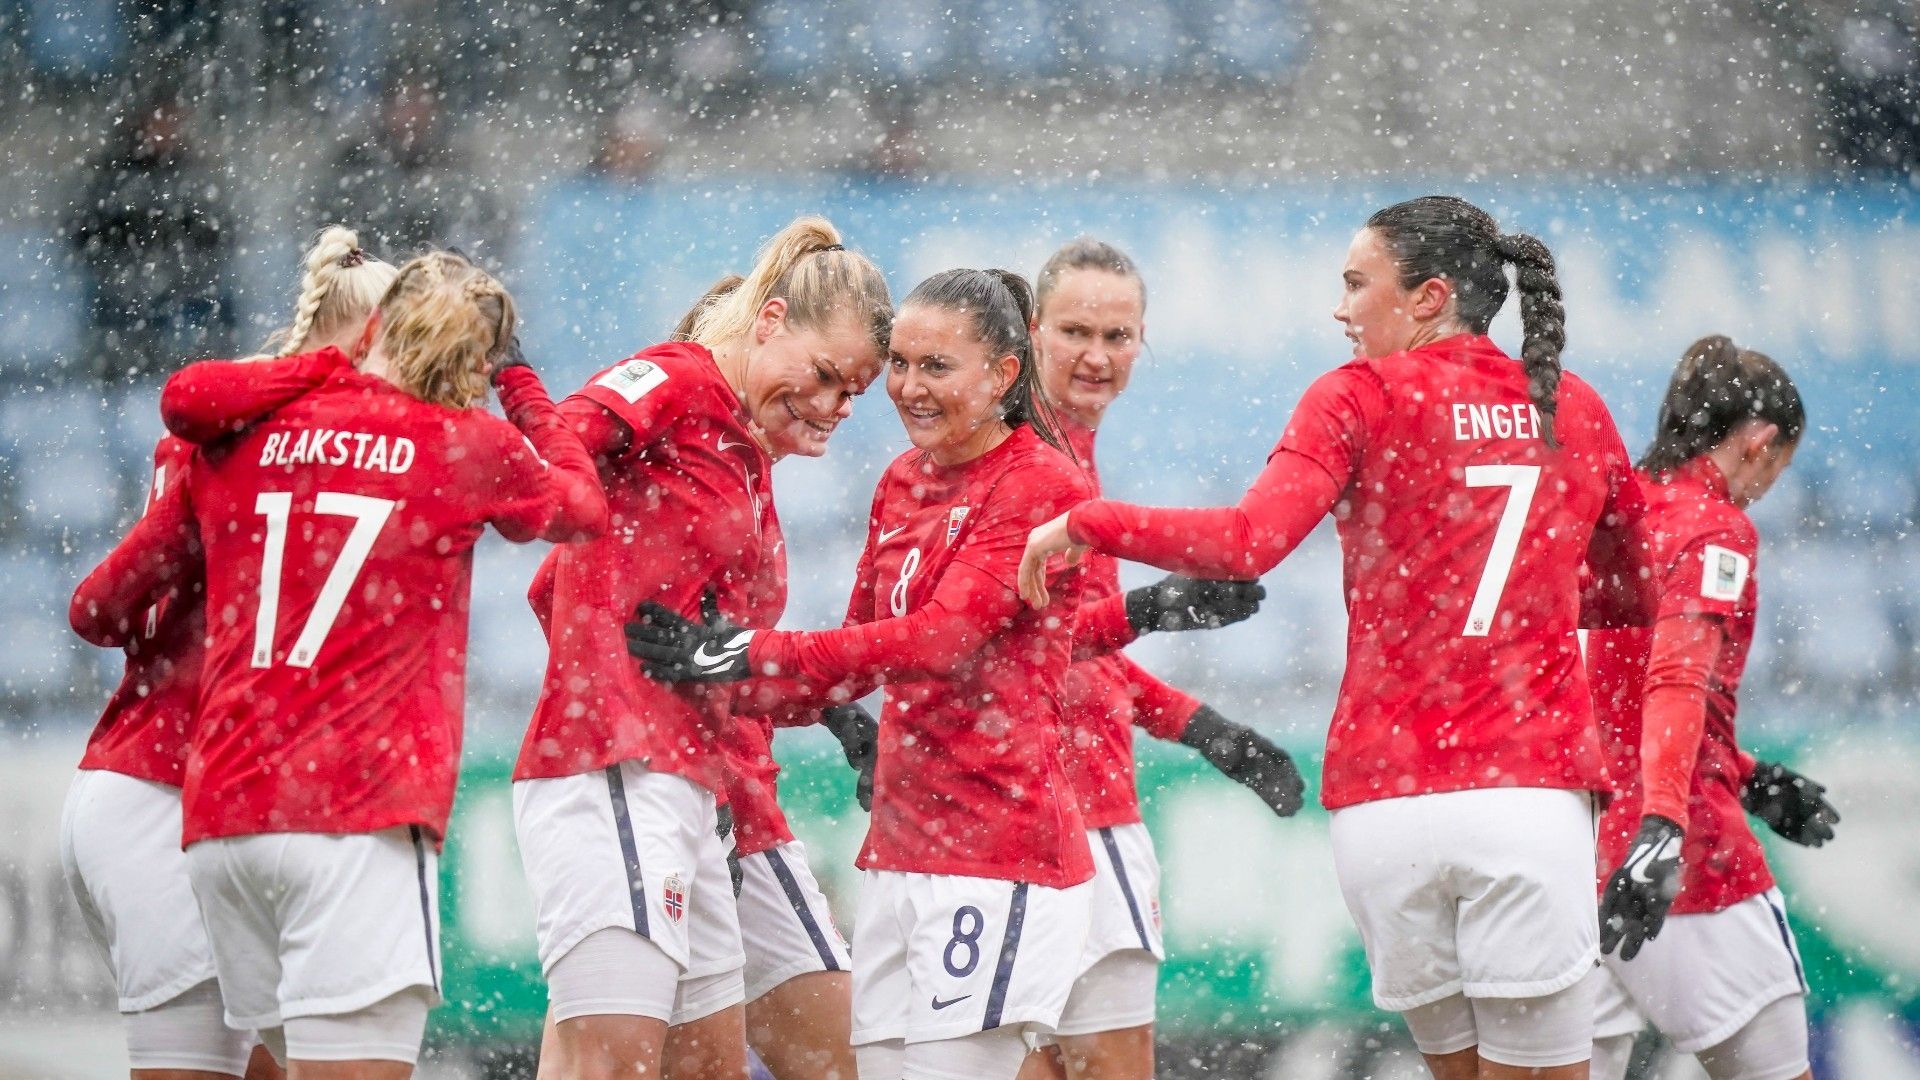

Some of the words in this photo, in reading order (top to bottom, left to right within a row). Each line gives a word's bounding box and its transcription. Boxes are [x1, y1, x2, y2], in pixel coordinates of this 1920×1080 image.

[259, 429, 415, 474] BLAKSTAD
[251, 491, 396, 668] 17
[890, 547, 920, 617] 8
[1462, 465, 1541, 637] 7
[943, 905, 984, 978] 8
